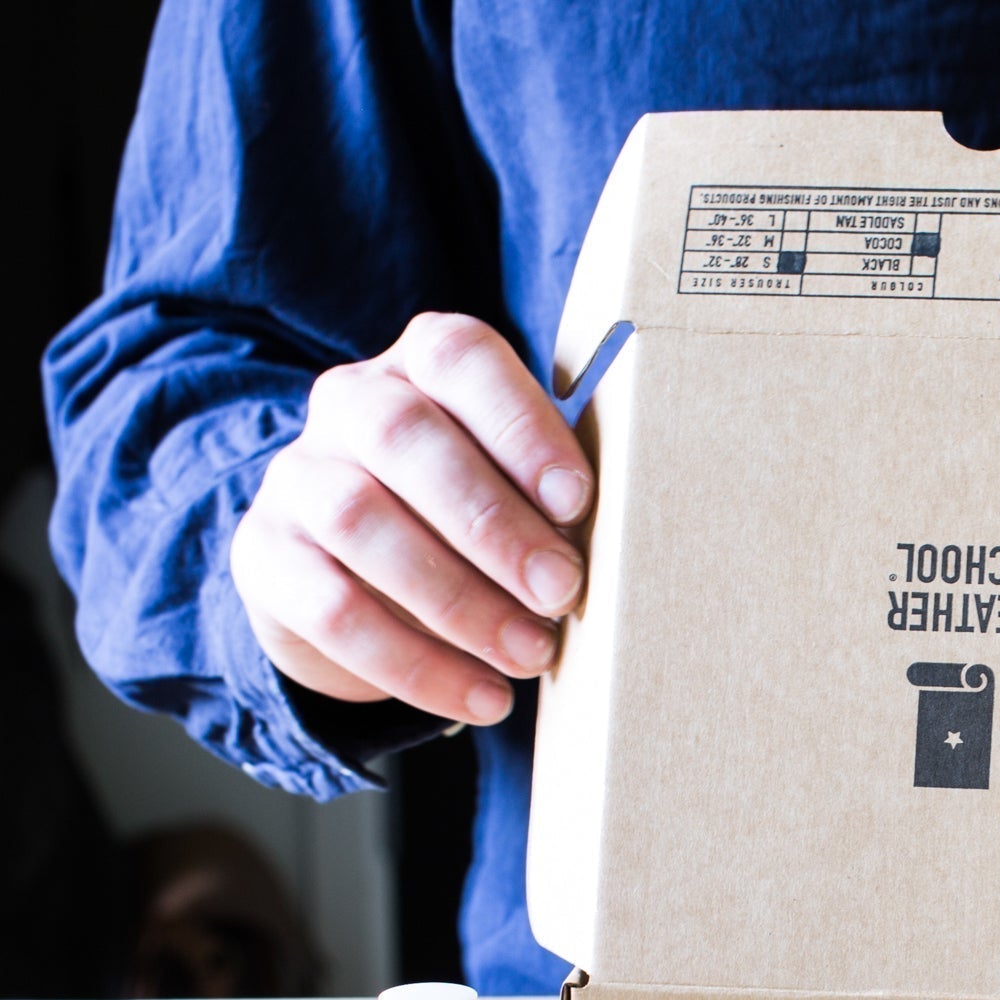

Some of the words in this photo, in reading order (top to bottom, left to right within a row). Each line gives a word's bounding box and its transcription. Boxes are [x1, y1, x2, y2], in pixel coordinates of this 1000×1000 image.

[759, 193, 811, 205] FINISHING
[814, 194, 827, 206] OF
[830, 195, 873, 206] AMOUNT
[876, 195, 907, 207] RIGHT
[909, 196, 927, 207] THE
[931, 196, 958, 208] JUST
[959, 197, 980, 208] AND
[768, 215, 775, 227] L
[836, 215, 858, 228] TAN
[860, 216, 905, 229] SADDLE
[764, 235, 775, 248] M
[864, 236, 903, 250] COCOA
[762, 256, 771, 268] S
[862, 258, 900, 271] BLACK
[692, 277, 722, 287] SIZE
[730, 279, 791, 289] TROUSER
[871, 281, 924, 292] COLOUR
